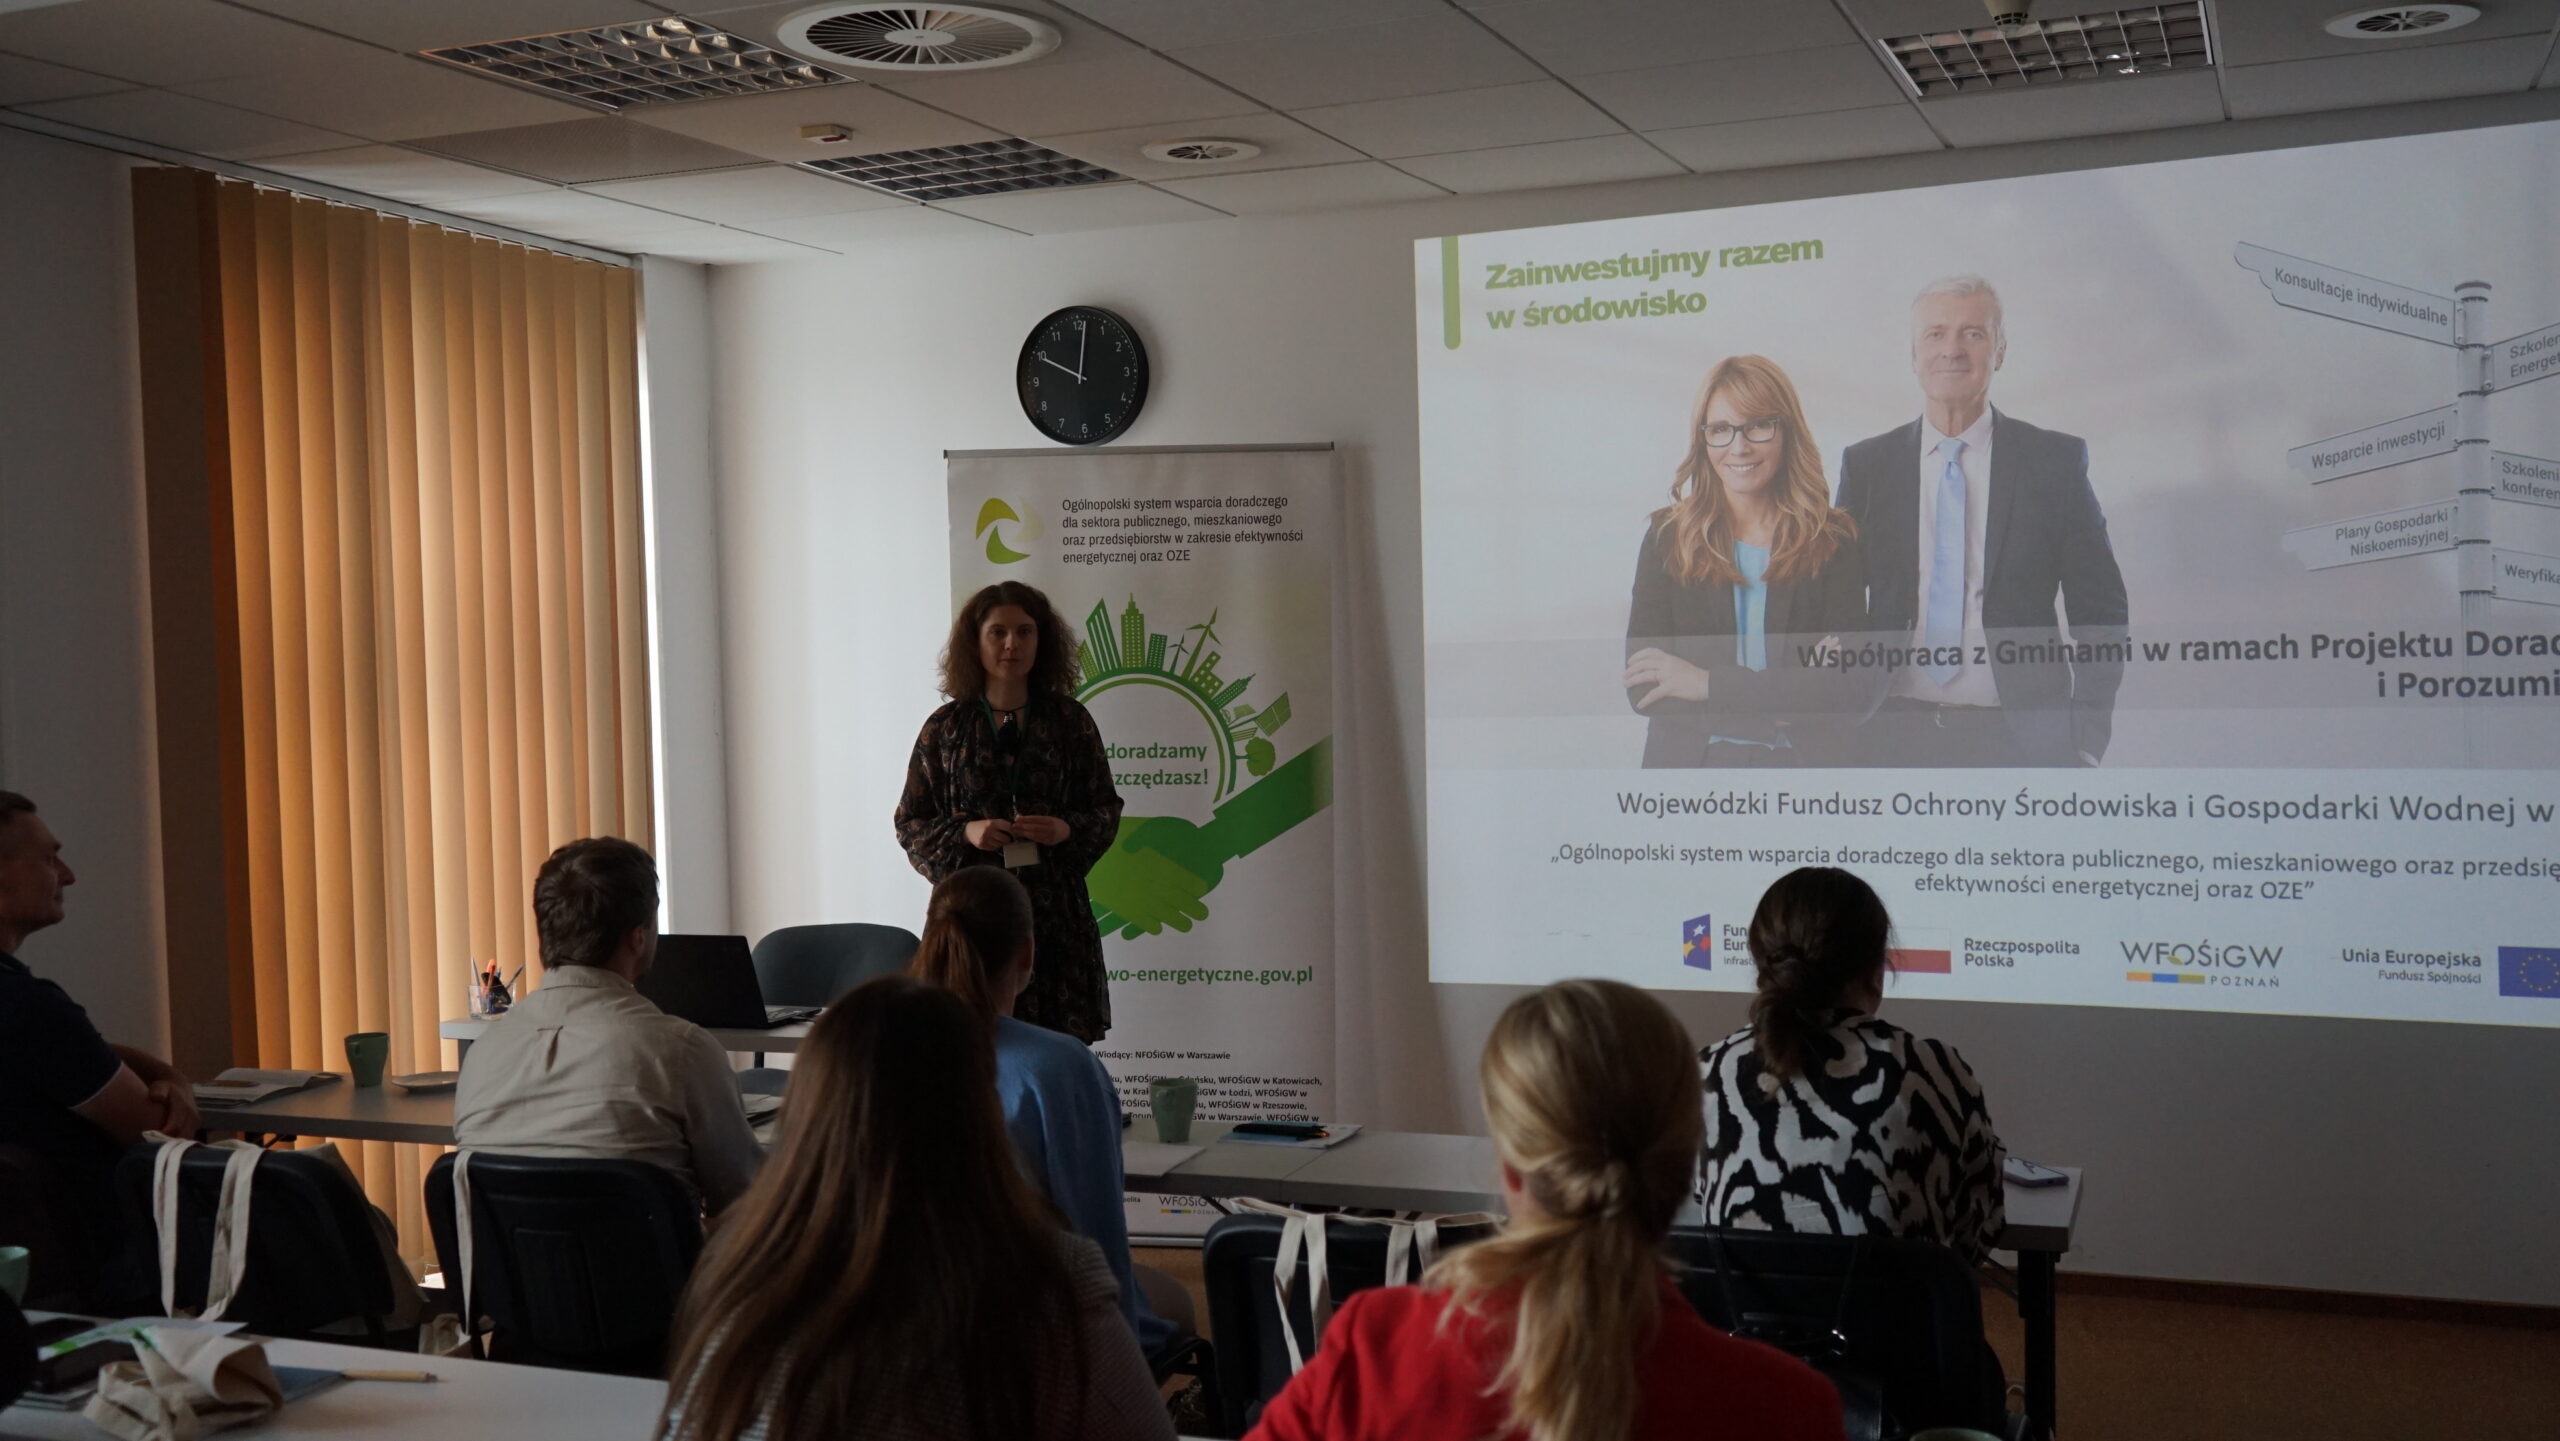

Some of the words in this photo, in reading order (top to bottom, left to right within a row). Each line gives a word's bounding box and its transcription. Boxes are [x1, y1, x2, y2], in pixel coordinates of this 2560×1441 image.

[1485, 248, 1711, 289] Zainwestujmy
[1718, 238, 1824, 269] razem
[2274, 267, 2353, 302] Konsultacje
[2357, 288, 2448, 327] indywidualne
[1486, 307, 1514, 330] w
[1522, 289, 1707, 327] środowisko
[1073, 320, 1083, 331] 12
[1100, 326, 1105, 336] 1
[1051, 331, 1061, 342] 11
[1115, 342, 1122, 352] 2
[1037, 351, 1047, 361] 10
[1123, 367, 1130, 377] 3
[1033, 377, 1039, 387] 9
[1121, 392, 1126, 401] 4
[1041, 401, 1047, 411] 8
[1058, 418, 1065, 428] 7
[1104, 413, 1111, 424] 5
[1081, 424, 1088, 434] 6
[2311, 443, 2373, 470] Wsparcie
[2376, 422, 2446, 453] inwestycji
[1062, 498, 1131, 513] Ogólnopolski
[1134, 498, 1172, 511] system
[1175, 497, 1222, 512] wsparcia
[1225, 495, 1288, 511] doradczego
[1062, 515, 1078, 529] dla
[1081, 514, 1120, 528] sektora
[1123, 513, 1190, 530] publicznego,
[1194, 512, 1282, 528] mieszkaniowego
[2335, 524, 2371, 541] Plany
[2374, 508, 2449, 535] Gospodarki
[1062, 534, 1085, 546] oraz
[1089, 531, 1172, 548] przedsiębiorstw
[1175, 534, 1184, 544] w
[1187, 530, 1231, 544] zakresie
[1234, 529, 1304, 545] efektywności
[2350, 529, 2449, 556] Niskoemisyjnej
[1063, 550, 1137, 565] energetycznej
[1140, 551, 1163, 562] oraz
[1167, 549, 1191, 561] OZE
[1797, 641, 1964, 674] Współpraca
[1973, 646, 1986, 665] z
[1995, 637, 2133, 665] Gminami
[2144, 642, 2171, 662] w
[2180, 633, 2299, 661] ramach
[2311, 630, 2453, 666] Projektu
[2378, 671, 2386, 698] i
[2398, 669, 2560, 698] Porozumi
[1105, 743, 1207, 762] doradzamy
[1115, 768, 1209, 789] zczędzasz!
[1617, 791, 1768, 819] Wojewódzki
[1778, 793, 1883, 816] Fundusz
[1892, 792, 2006, 821] Ochrony
[2014, 787, 2178, 819] Środowiska
[2188, 794, 2194, 818] i
[2204, 794, 2379, 824] Gospodarki
[2389, 795, 2515, 827] Wodnej
[2527, 804, 2555, 823] w
[1551, 843, 1674, 864] „Ogólnopolski
[1680, 846, 1743, 866] system
[1749, 846, 1830, 866] wsparcia
[1836, 846, 1948, 869] doradczego
[1955, 848, 1984, 866] dla
[1990, 848, 2065, 867] sektora
[2072, 849, 2204, 873] publicznego,
[2213, 853, 2397, 878] mieszkaniowego
[2404, 859, 2454, 875] oraz
[1915, 873, 2046, 896] efektywności
[2052, 878, 2200, 901] energetycznej
[2207, 884, 2253, 899] oraz
[1964, 938, 2080, 955] Rzeczpospolita
[2120, 940, 2283, 969] WFOŚiGW
[1964, 954, 2014, 967] Polska
[2342, 948, 2379, 963] Unia
[2385, 949, 2481, 969] Europejska
[1106, 966, 1313, 985] wo-energetyczne.gov.pl
[2210, 974, 2280, 987] POZNAŃ
[2378, 969, 2424, 982] Fundusz
[2427, 971, 2481, 985] Spójności
[1096, 1050, 1133, 1061] Wiodący:
[1135, 1050, 1175, 1060] NFOŚiGW
[1187, 1051, 1231, 1060] Warszawie
[1218, 1076, 1260, 1085] WFOŚiGW
[1272, 1077, 1323, 1087] Katowicach,
[1229, 1088, 1253, 1098] Łodzi,
[1255, 1088, 1297, 1097] WFOŚiGW
[1208, 1101, 1250, 1110] WFOŚiGW
[1262, 1102, 1307, 1111] Rzeszowie,
[1266, 1113, 1309, 1122] WFOŚiGW
